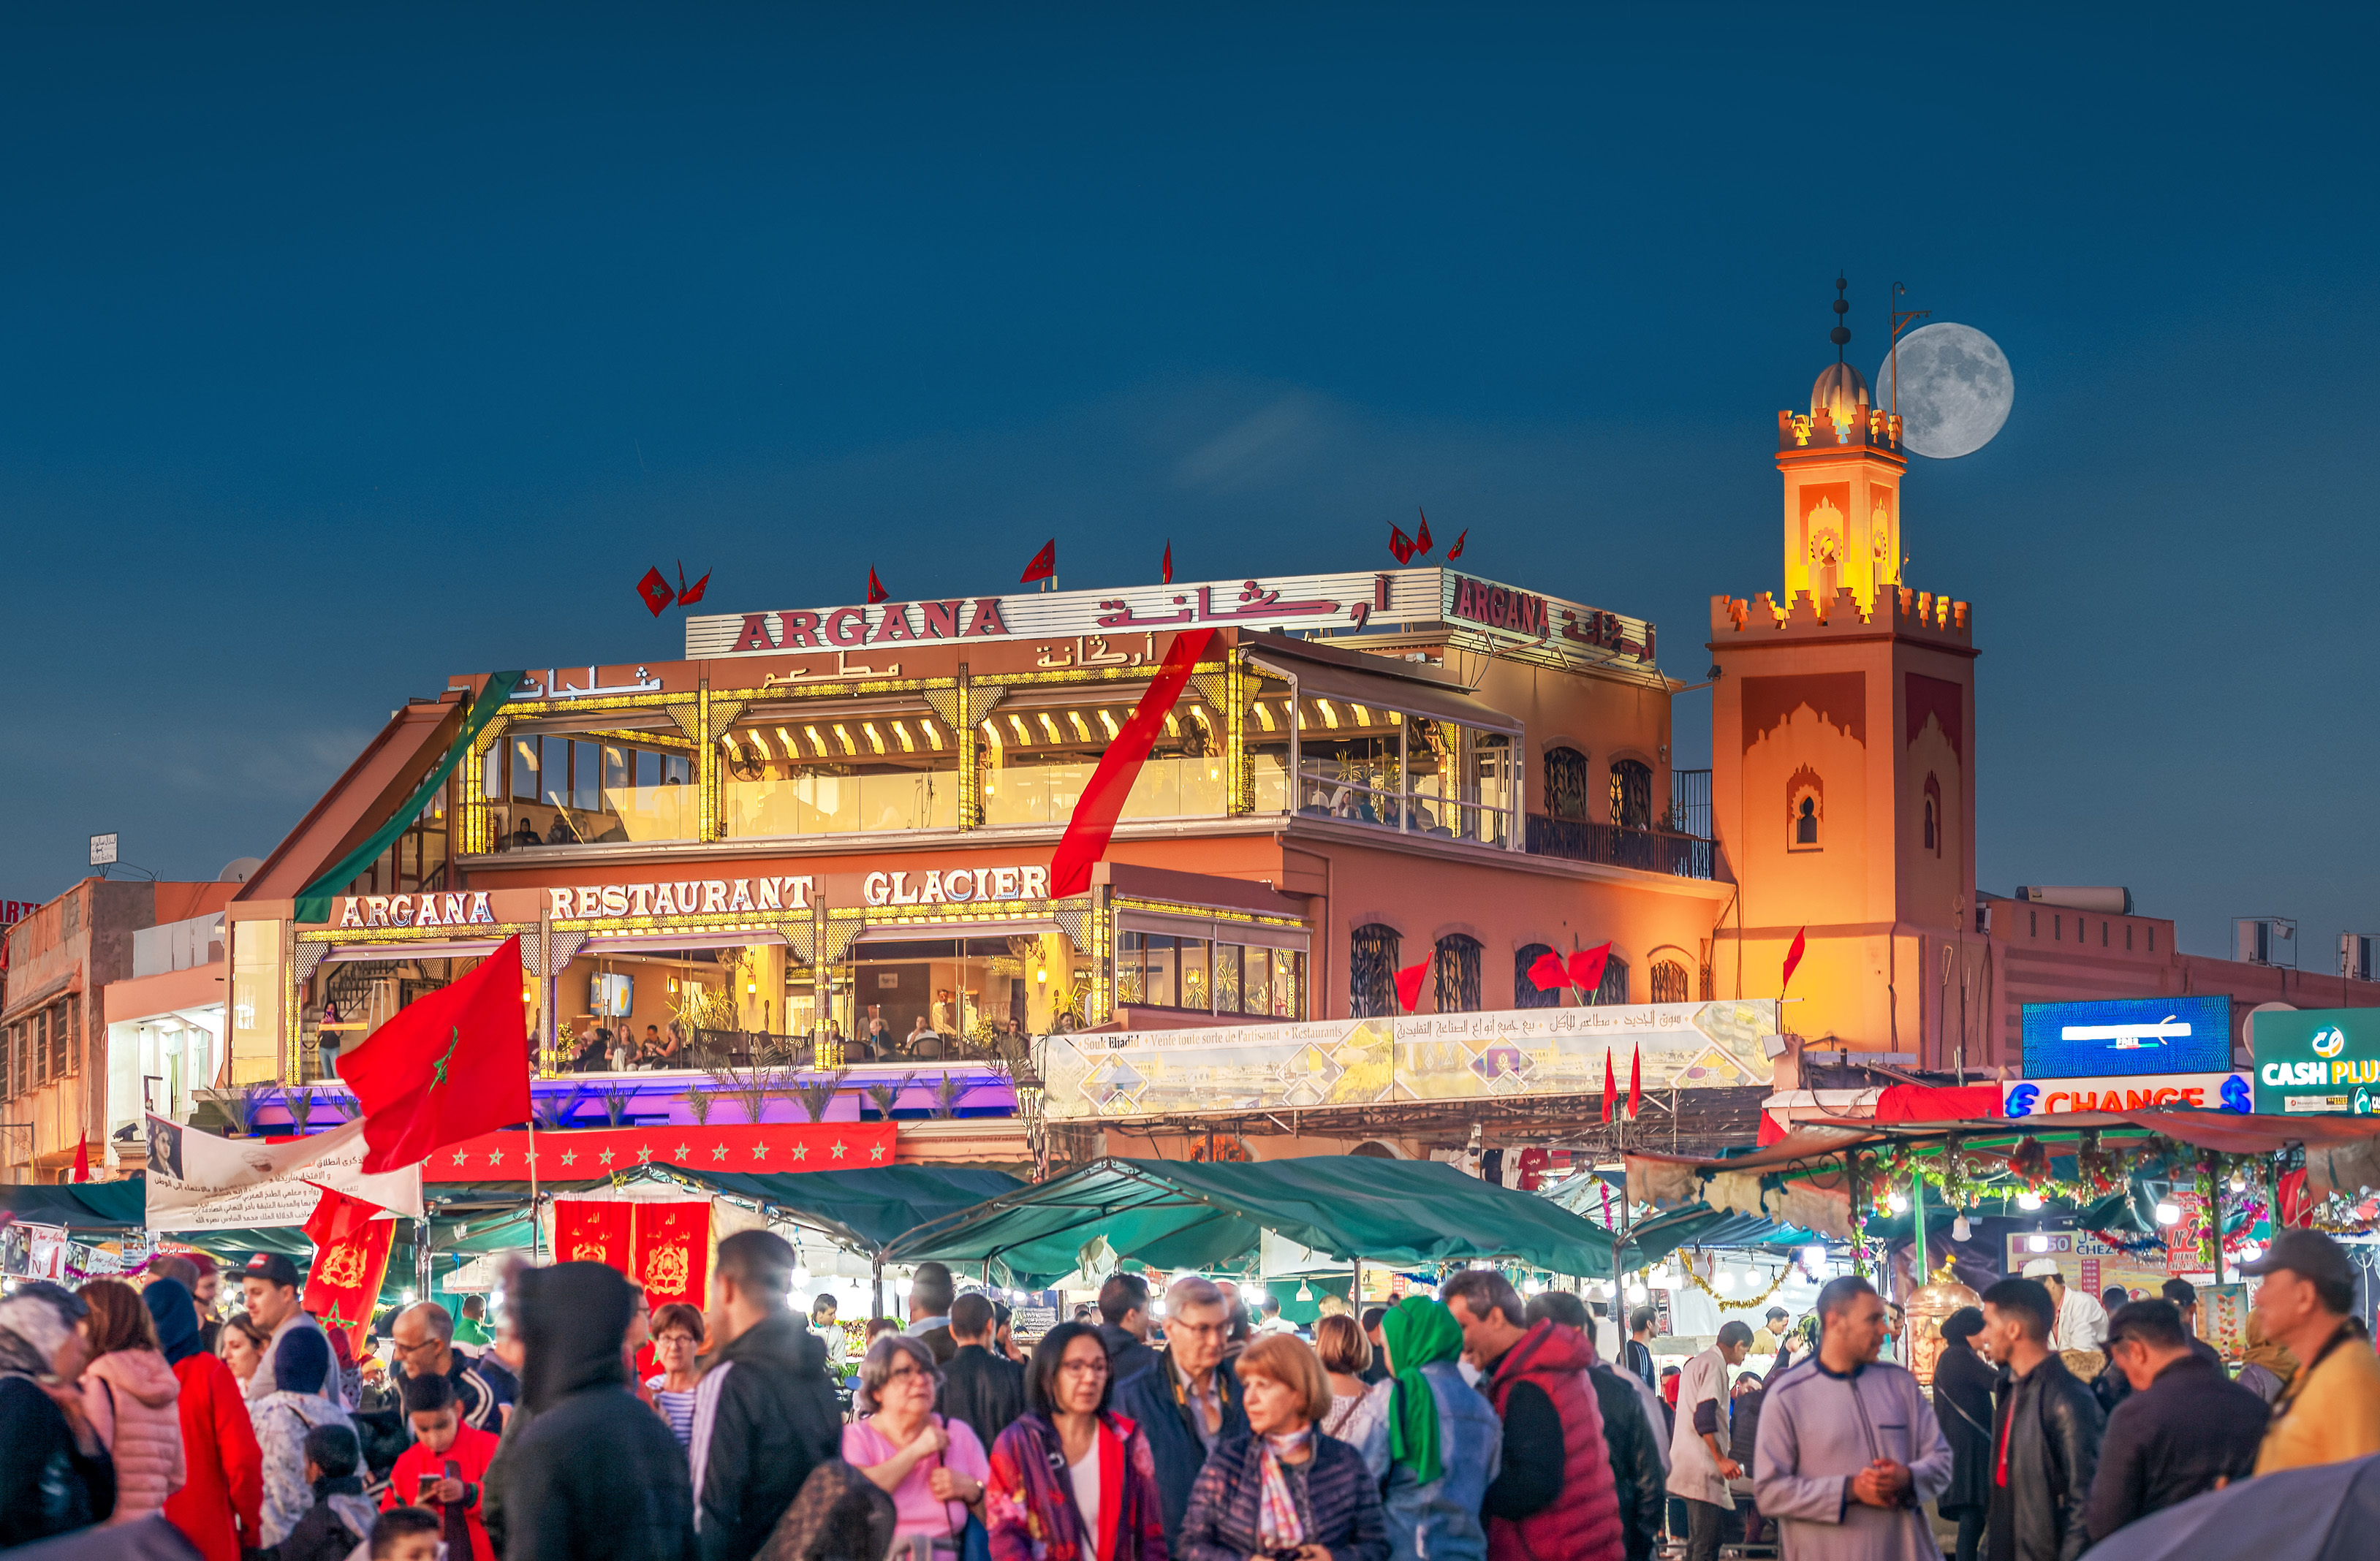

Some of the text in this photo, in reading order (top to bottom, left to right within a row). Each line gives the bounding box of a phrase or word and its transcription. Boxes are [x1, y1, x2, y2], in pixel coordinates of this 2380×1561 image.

[1450, 574, 1551, 639] ARGANA
[731, 599, 1011, 652] ARGANA
[762, 650, 901, 689] مطعم
[341, 865, 1049, 928] ARGANA RESTAURANT GLACIER
[1436, 1018, 1468, 1038] الصناعة
[1623, 1009, 1656, 1028] الجديد
[1659, 1013, 1681, 1028] سوق
[1083, 1025, 1343, 1053] Souk Eljadid Vente toute sorte de l'artisanat Restaurants
[2262, 1061, 2327, 1087] CASH
[2044, 1087, 2204, 1113] CHANGE
[2220, 1074, 2251, 1114] $
[2076, 1245, 2114, 1256] CHEZ
